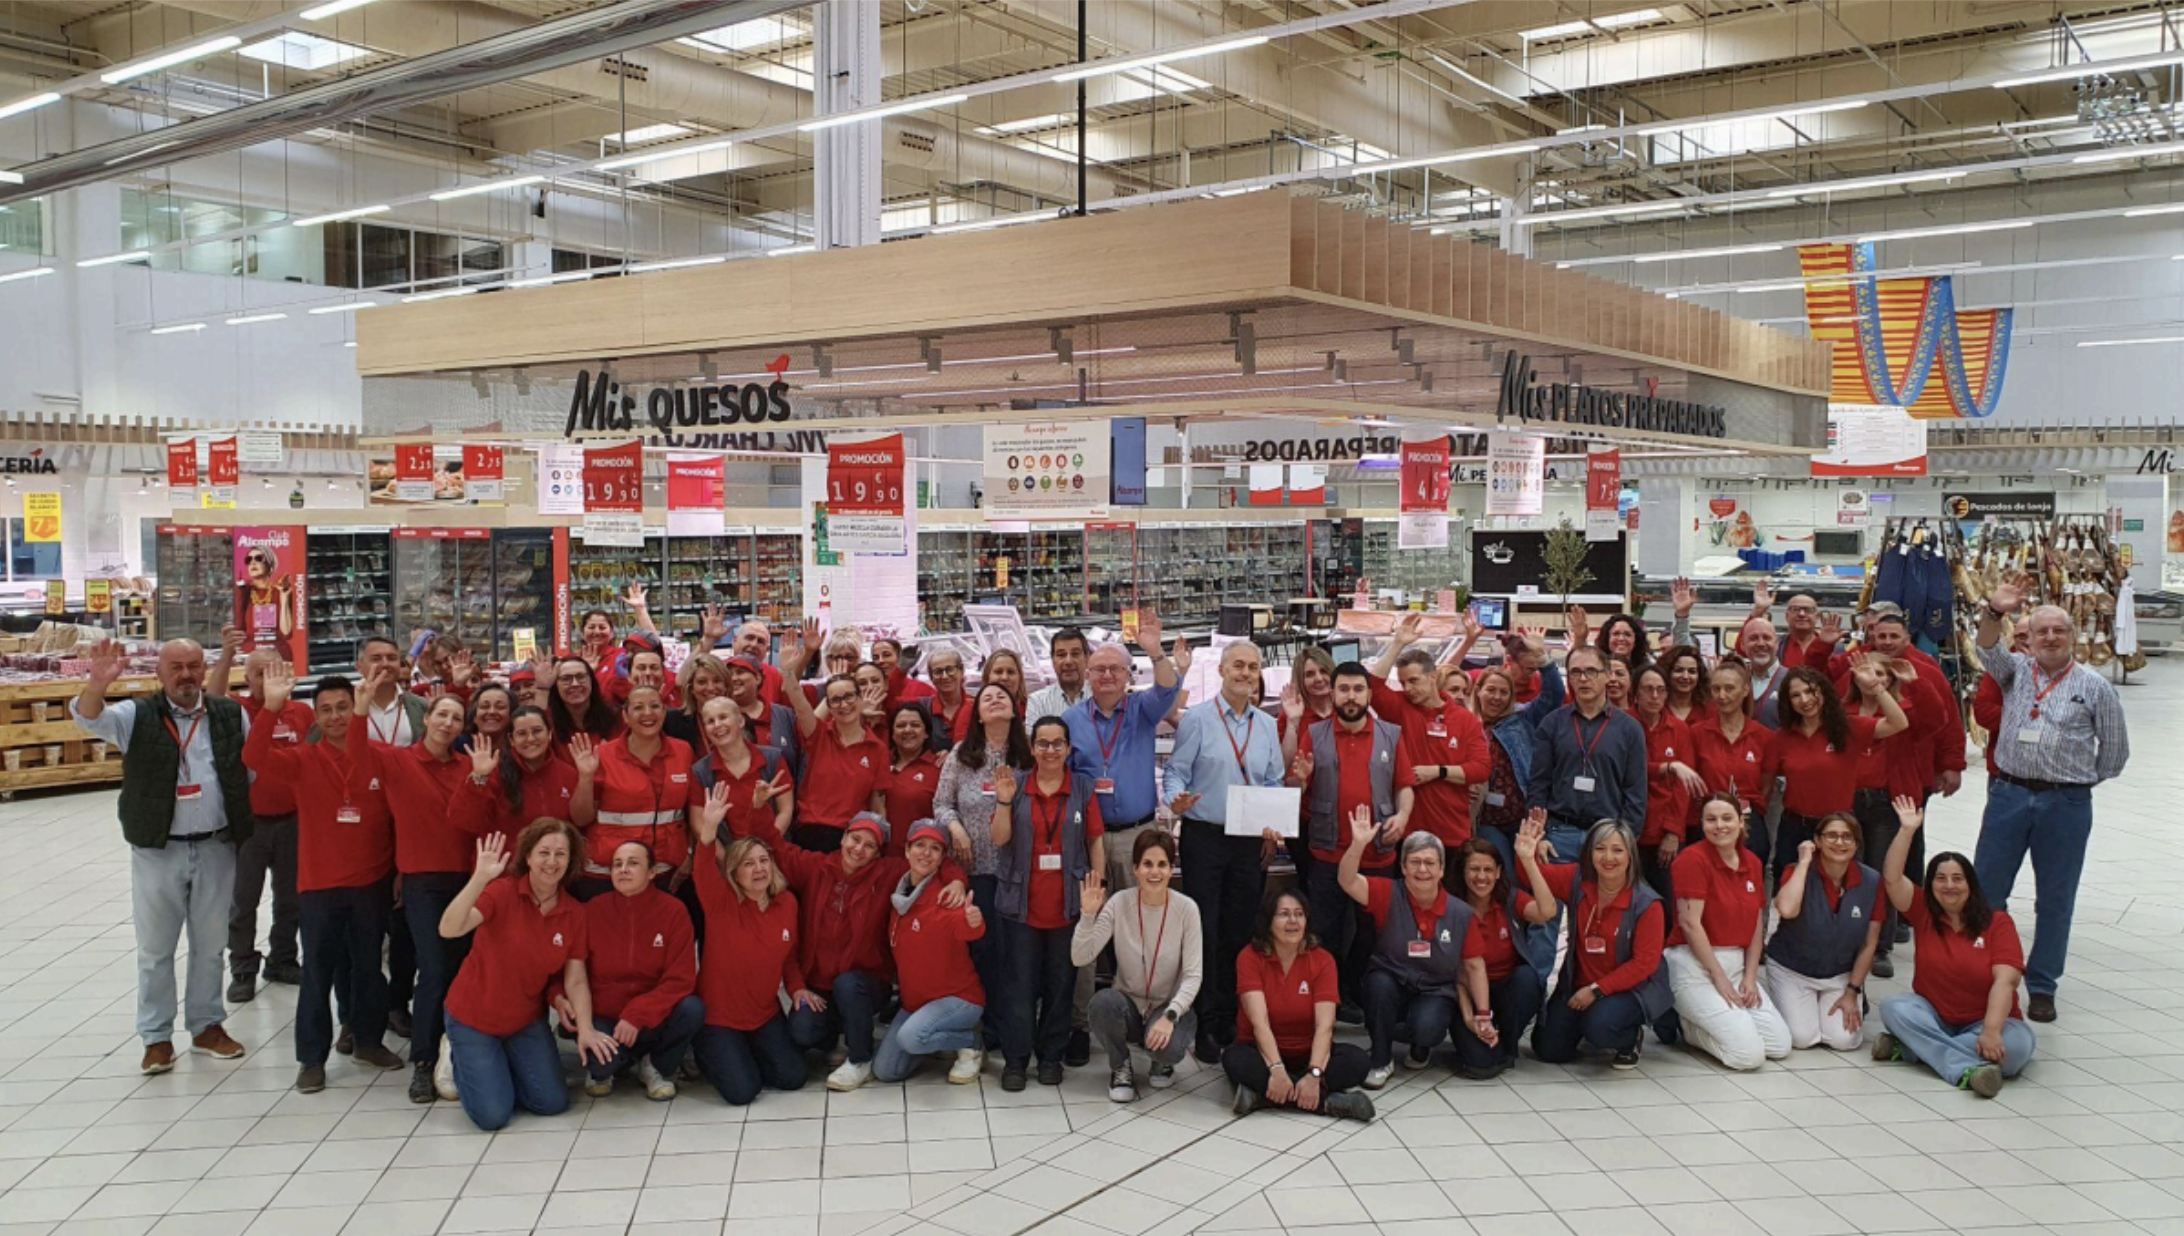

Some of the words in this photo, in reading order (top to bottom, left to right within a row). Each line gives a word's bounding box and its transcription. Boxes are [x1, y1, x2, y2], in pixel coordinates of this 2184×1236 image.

[564, 369, 636, 437] Mis
[648, 380, 792, 434] QUESOS
[1497, 349, 1548, 424] Mis
[1552, 382, 1624, 428] PLATOS
[1623, 391, 1727, 438] PREPARADOS
[591, 455, 634, 468] PROMOCIÓN
[839, 450, 893, 464] PROMOCIÓN
[2136, 449, 2177, 475] Mi
[1970, 502, 2012, 511] Pescados
[2013, 502, 2025, 511] de
[238, 535, 289, 548] Alcampo
[268, 530, 289, 538] Club
[295, 573, 305, 630] PROMOCIÓN
[557, 583, 567, 650] PROMOCIÓN
